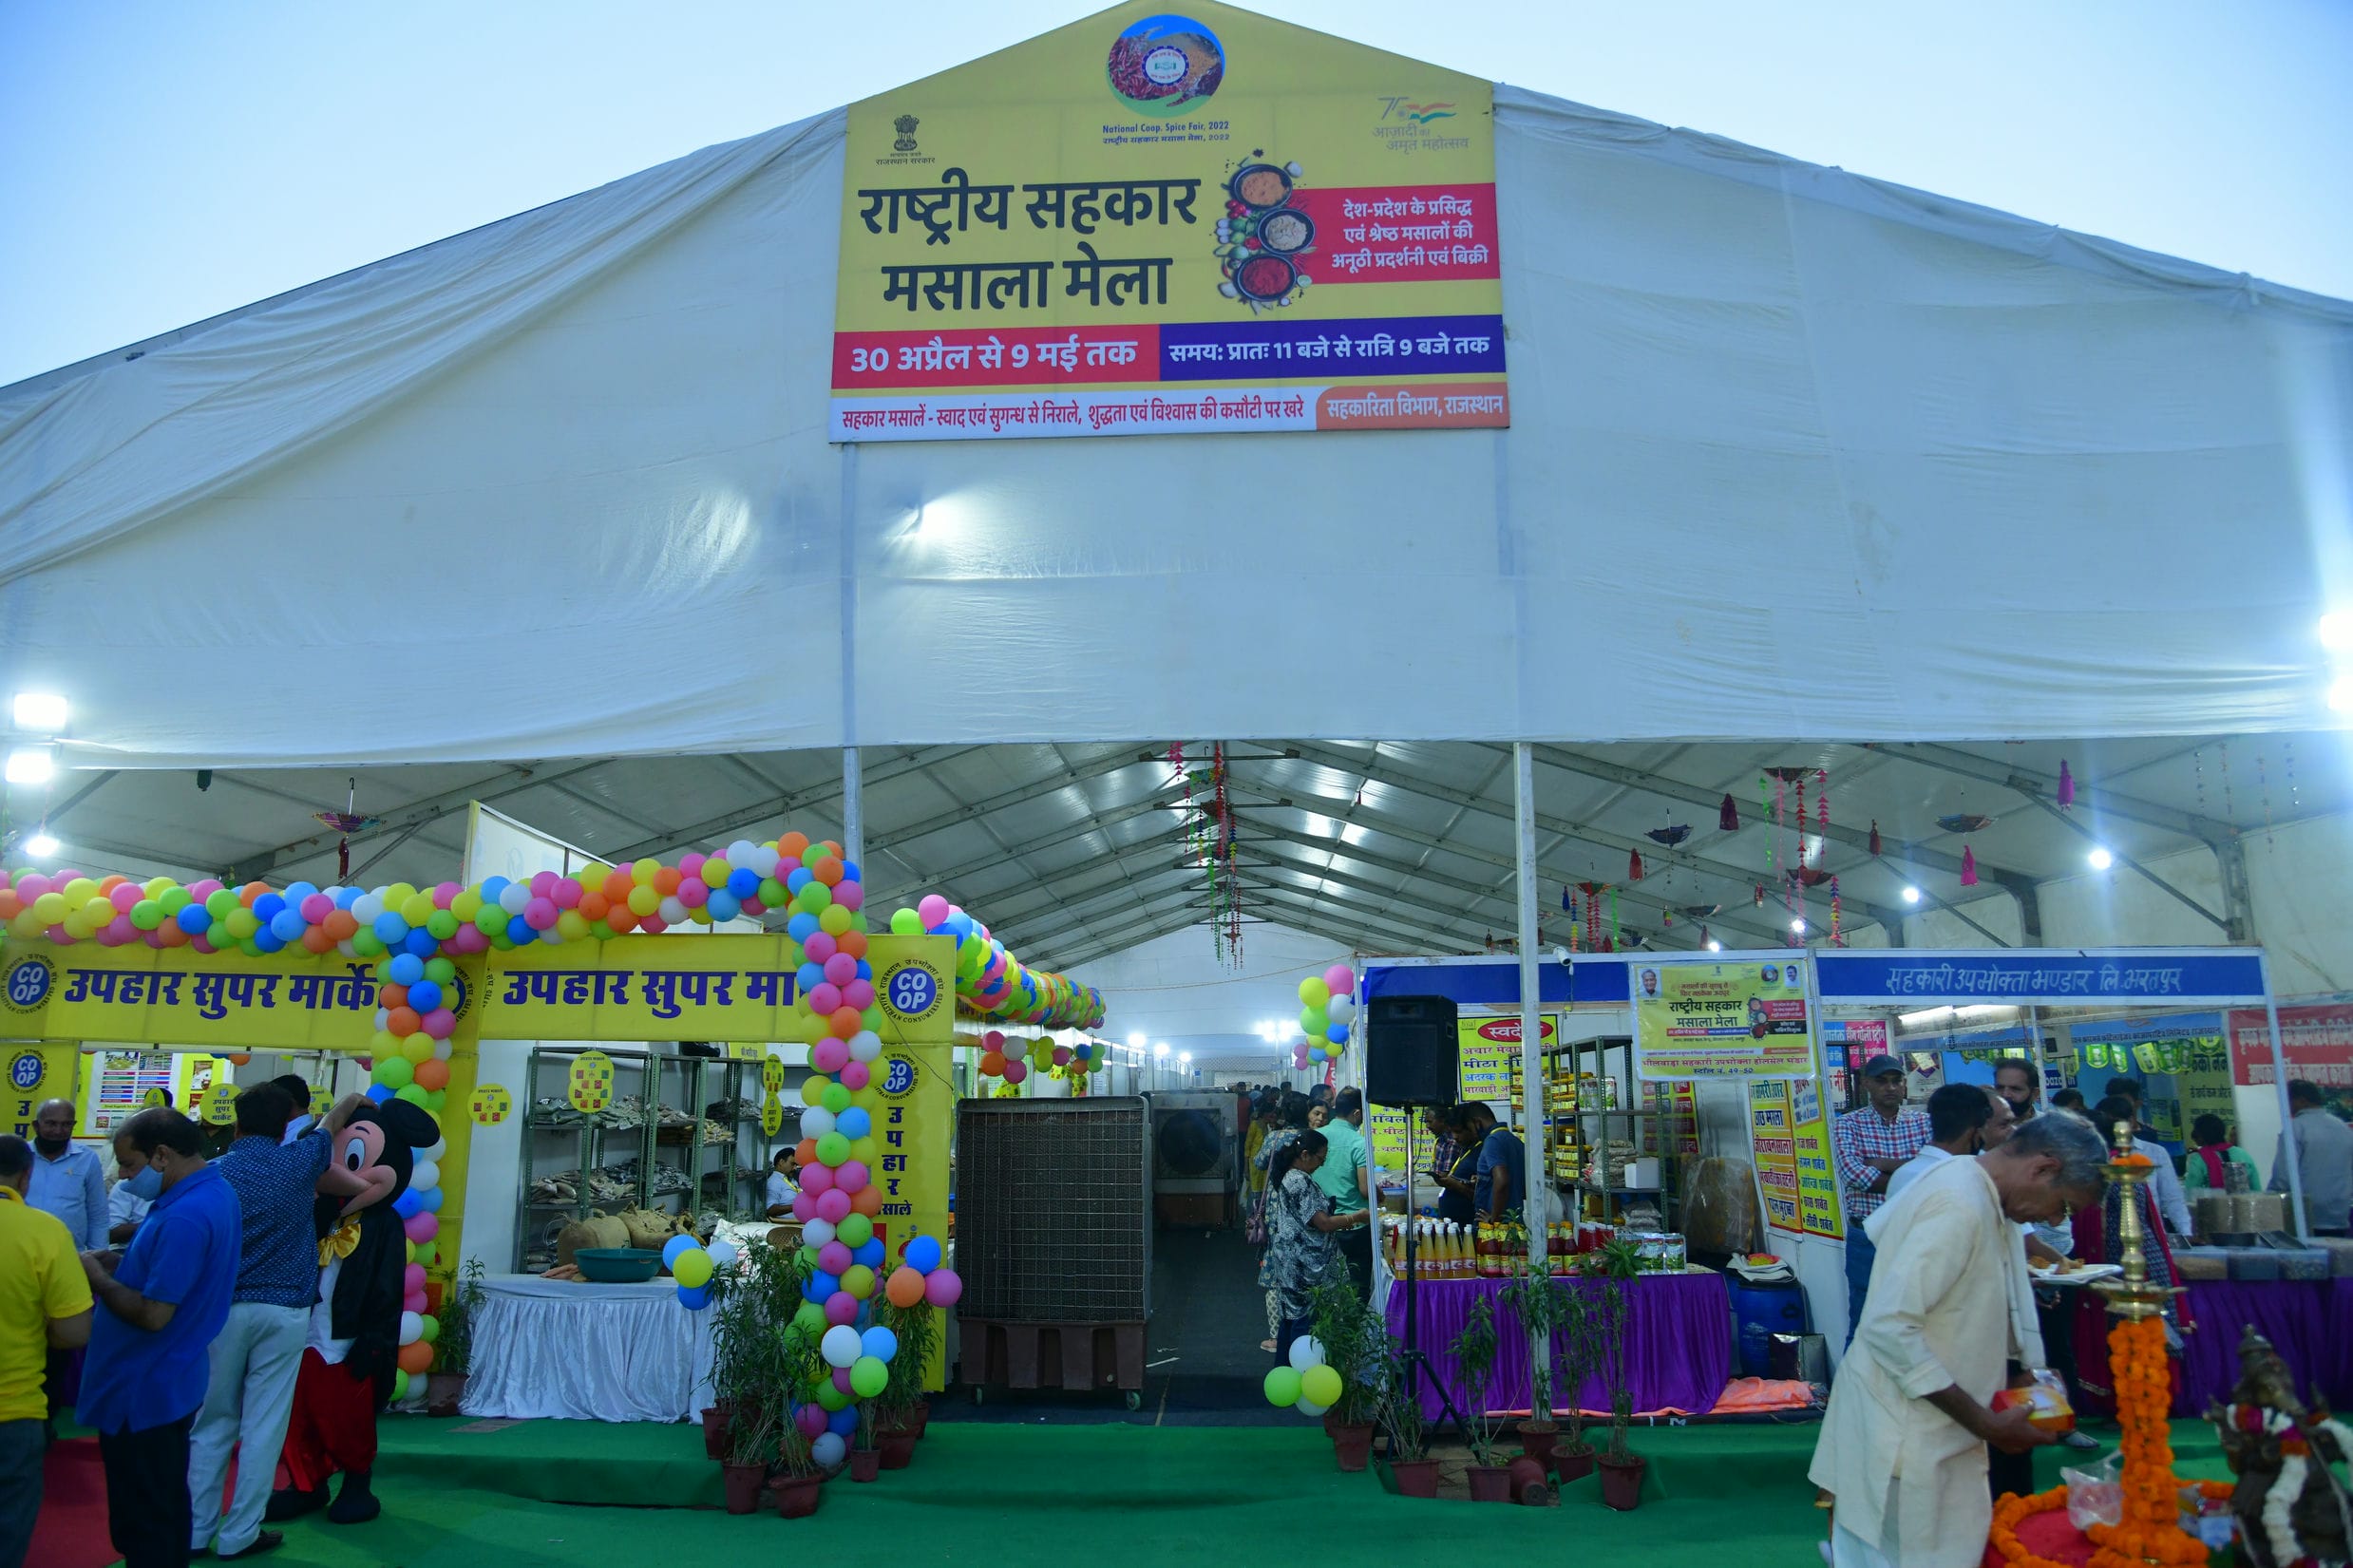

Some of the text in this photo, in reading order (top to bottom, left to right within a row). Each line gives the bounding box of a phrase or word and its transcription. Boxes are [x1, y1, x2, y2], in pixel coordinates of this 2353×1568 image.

[1103, 122, 1228, 135] National Coop. Spice Fair, 2022
[875, 158, 908, 166] राजस्थान
[858, 167, 1202, 246] राष्ट्रीय सहकार
[1342, 196, 1472, 217] देश-प्रदेश के प्रसिद्ध
[1343, 221, 1473, 243] एवं श्रेष्ठ मसालों की
[1332, 244, 1489, 273] अनूठी प्रदर्शनी एवं बिक्री
[882, 241, 1173, 312] मसाला मेला
[850, 333, 1139, 373] 30 अप्रैल से 9 मई तक
[1273, 342, 1292, 359] 11
[1297, 334, 1329, 359] बजे
[1332, 334, 1353, 358] से
[1356, 332, 1395, 358] रात्रि
[1400, 339, 1413, 356] 9
[1416, 331, 1452, 355] बजे
[1454, 336, 1490, 354] तक
[842, 410, 886, 430] सहकार
[887, 403, 926, 427] मसालें
[937, 408, 966, 429] स्वाद
[968, 403, 988, 425] एवं
[989, 406, 1026, 432] सुगन्ध
[1028, 400, 1043, 425] से
[1043, 398, 1083, 426] निराले,
[1088, 404, 1129, 429] शुद्धता
[1130, 399, 1149, 423] एवं
[1150, 396, 1197, 422] विश्वास
[1200, 395, 1218, 420] की
[1220, 394, 1262, 419] कसौटी
[1264, 400, 1281, 418] पर
[1283, 393, 1304, 418] खरे
[1326, 390, 1504, 419] सहकारिता विभाग, राजस्थान
[17, 966, 44, 984] CO
[897, 973, 927, 991] CO
[1886, 964, 1955, 994] सहकारी
[1956, 964, 2031, 992] उपभोक्ता
[2031, 969, 2094, 993] भण्डार
[13, 984, 41, 1001] OP
[65, 963, 386, 1021] उपहार सुपर मार्के
[503, 971, 635, 1006] उपहार
[641, 971, 738, 1020] सुपर
[897, 992, 927, 1010] OP
[1669, 998, 1742, 1014] राष्ट्रीय सहकार
[1677, 1013, 1737, 1028] मसाला मेला
[18, 1058, 38, 1071] CO
[16, 1072, 37, 1085] OP
[884, 1077, 906, 1090] OP
[877, 1200, 913, 1217] साले
